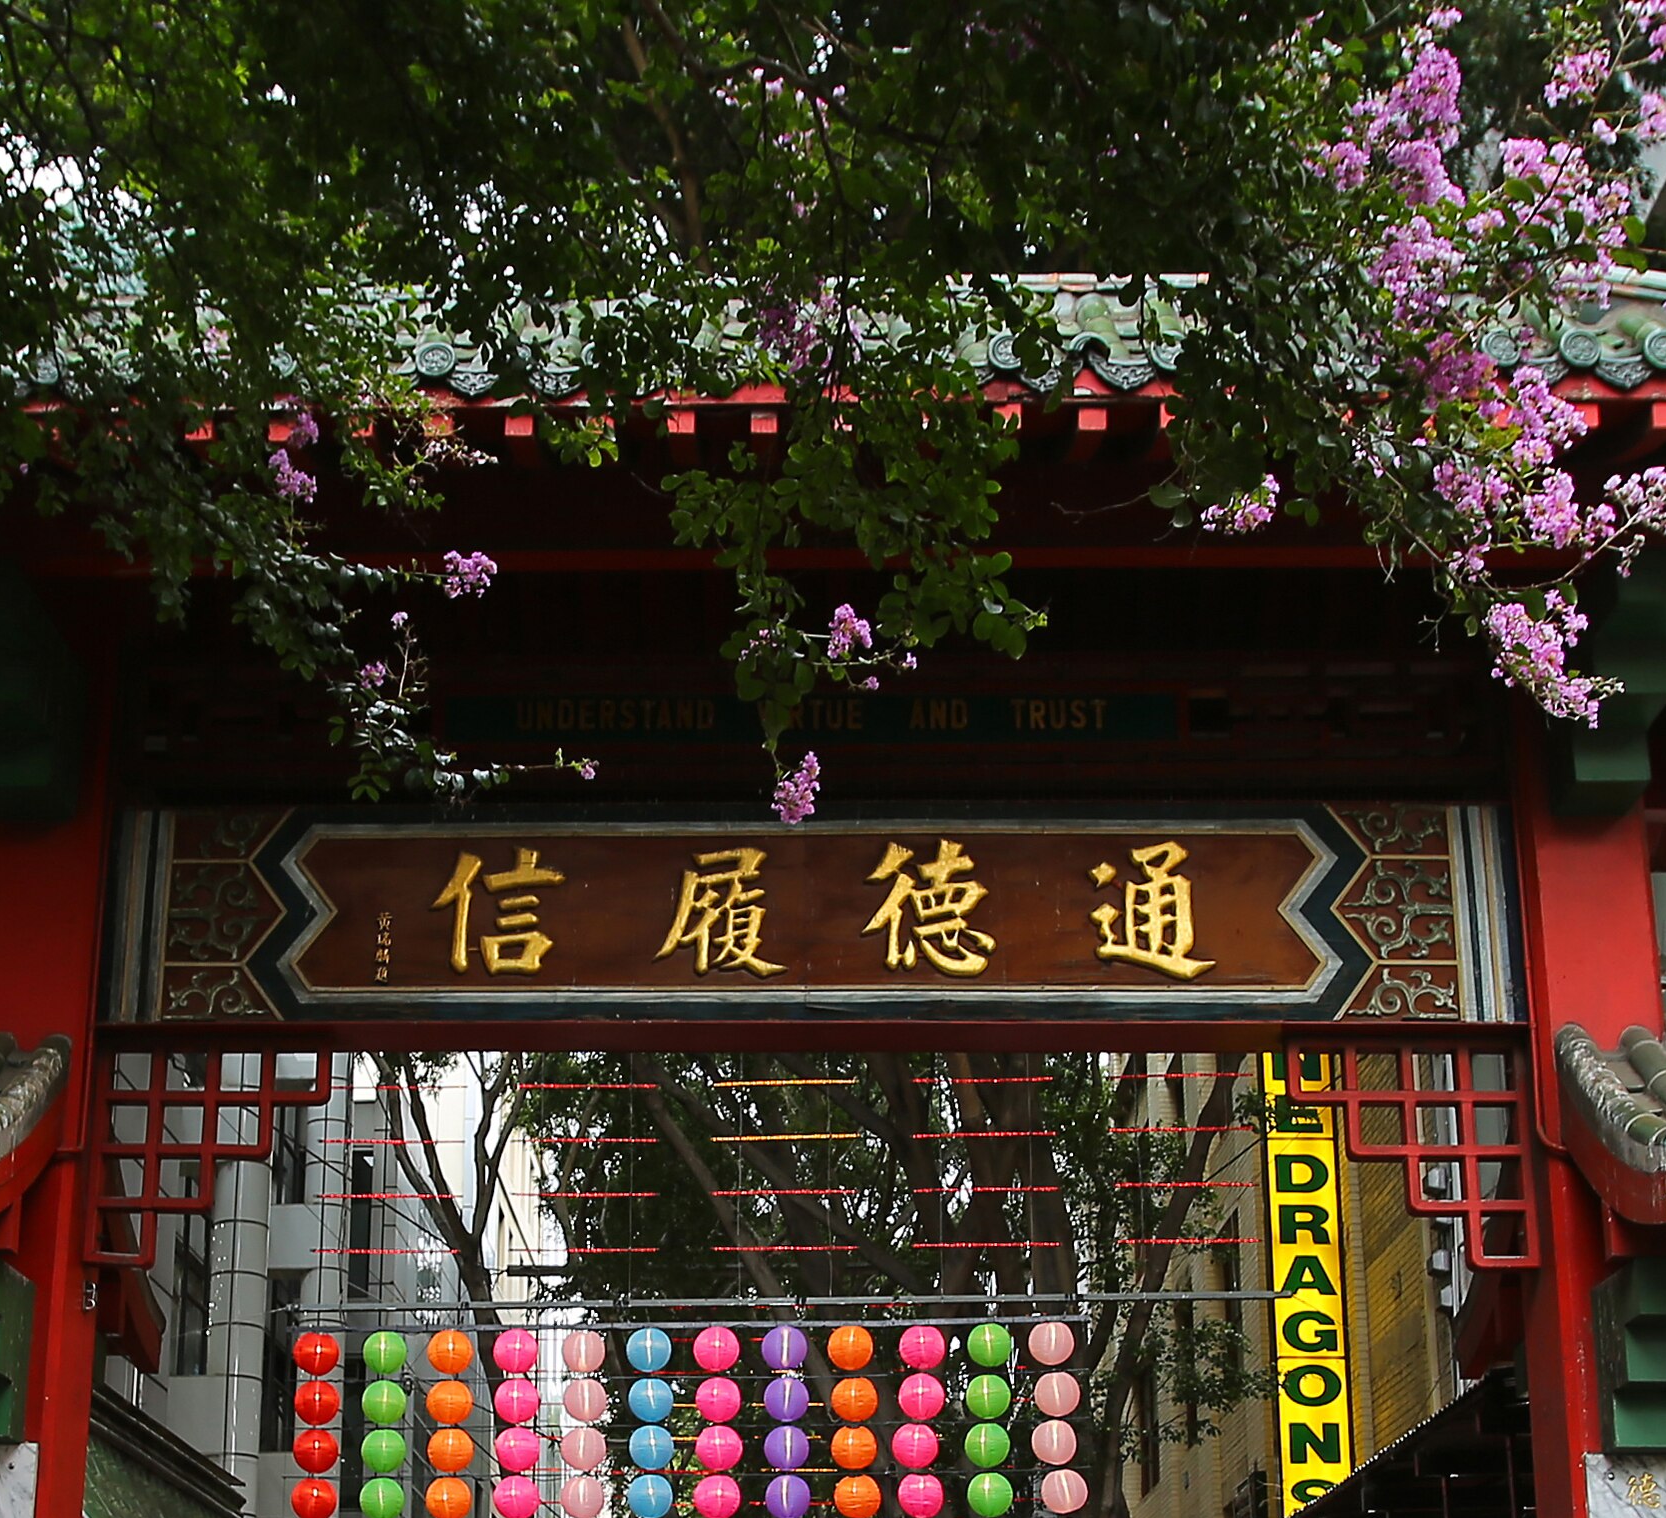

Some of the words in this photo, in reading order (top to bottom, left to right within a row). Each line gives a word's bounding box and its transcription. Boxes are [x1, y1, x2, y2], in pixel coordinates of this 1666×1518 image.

[517, 699, 715, 732] UNDERSTAND
[757, 698, 864, 731] RTUE
[909, 698, 969, 731] AND
[1011, 697, 1107, 731] TRUST
